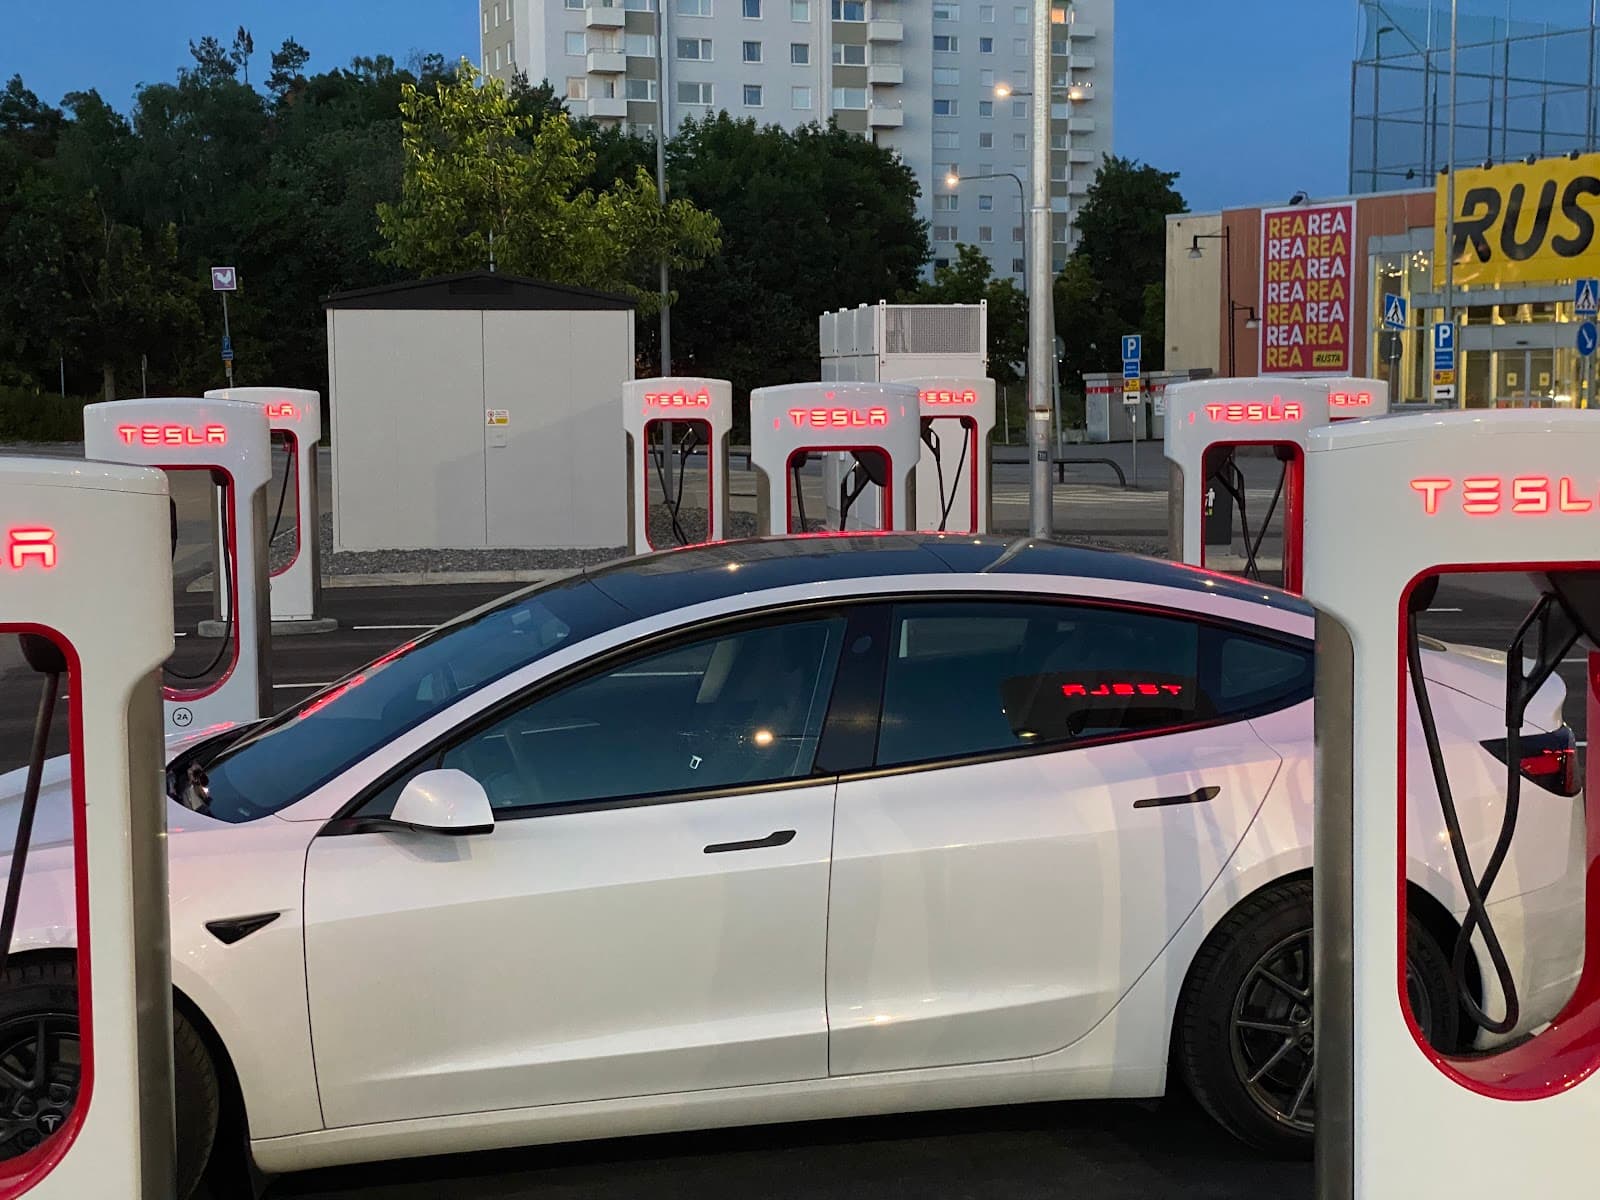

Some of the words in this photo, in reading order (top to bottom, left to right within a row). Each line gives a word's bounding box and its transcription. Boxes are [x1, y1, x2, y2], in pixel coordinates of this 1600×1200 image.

[1269, 215, 1306, 238] REA
[1307, 211, 1346, 235] REA
[1268, 237, 1305, 260] REA
[1307, 234, 1346, 257] REA
[1268, 259, 1305, 281] REA
[1306, 256, 1345, 279] REA
[1267, 281, 1304, 304] REA
[1306, 278, 1344, 302] REA
[1267, 302, 1304, 324] REA
[1306, 300, 1344, 323] REA
[1266, 324, 1303, 346] REA
[1305, 323, 1344, 345] REA
[1439, 325, 1451, 347] P
[1127, 338, 1137, 358] P
[1266, 346, 1303, 368] REA
[645, 393, 708, 407] TESLA
[790, 407, 888, 427] TESLA
[1205, 404, 1300, 421] TESLA
[119, 426, 226, 444] TESLA
[1410, 477, 1600, 515] TESL
[177, 713, 189, 721] 2A
